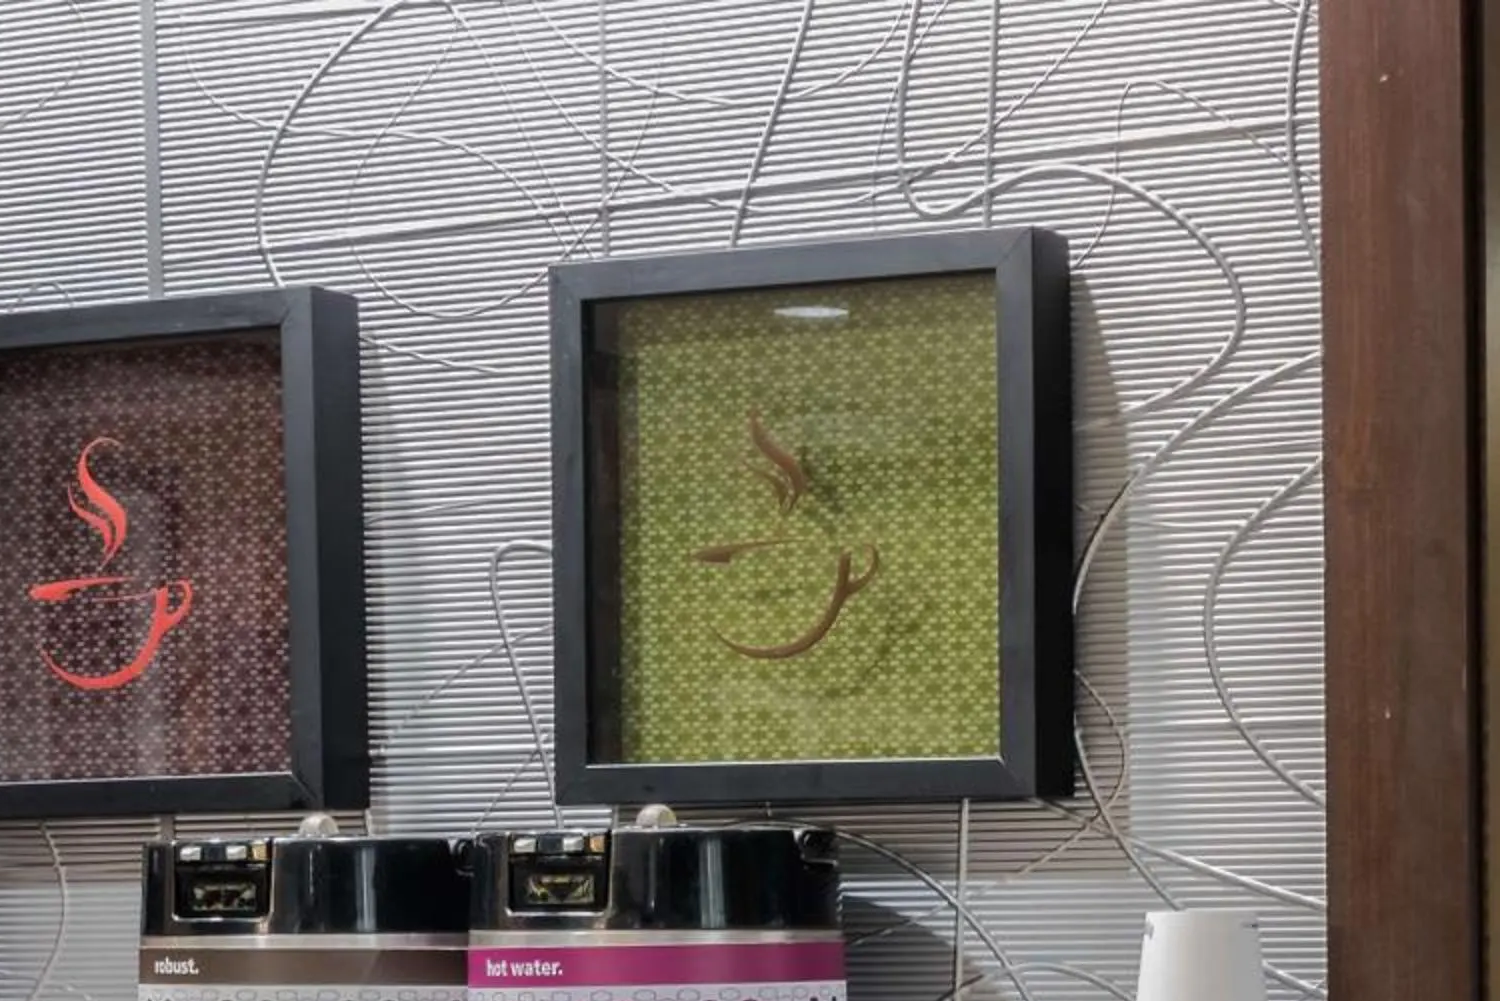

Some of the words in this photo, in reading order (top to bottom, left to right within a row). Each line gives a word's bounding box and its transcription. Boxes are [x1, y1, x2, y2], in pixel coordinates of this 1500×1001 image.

[154, 956, 199, 975] robust.
[487, 958, 507, 977] hot
[510, 960, 563, 977] water.
